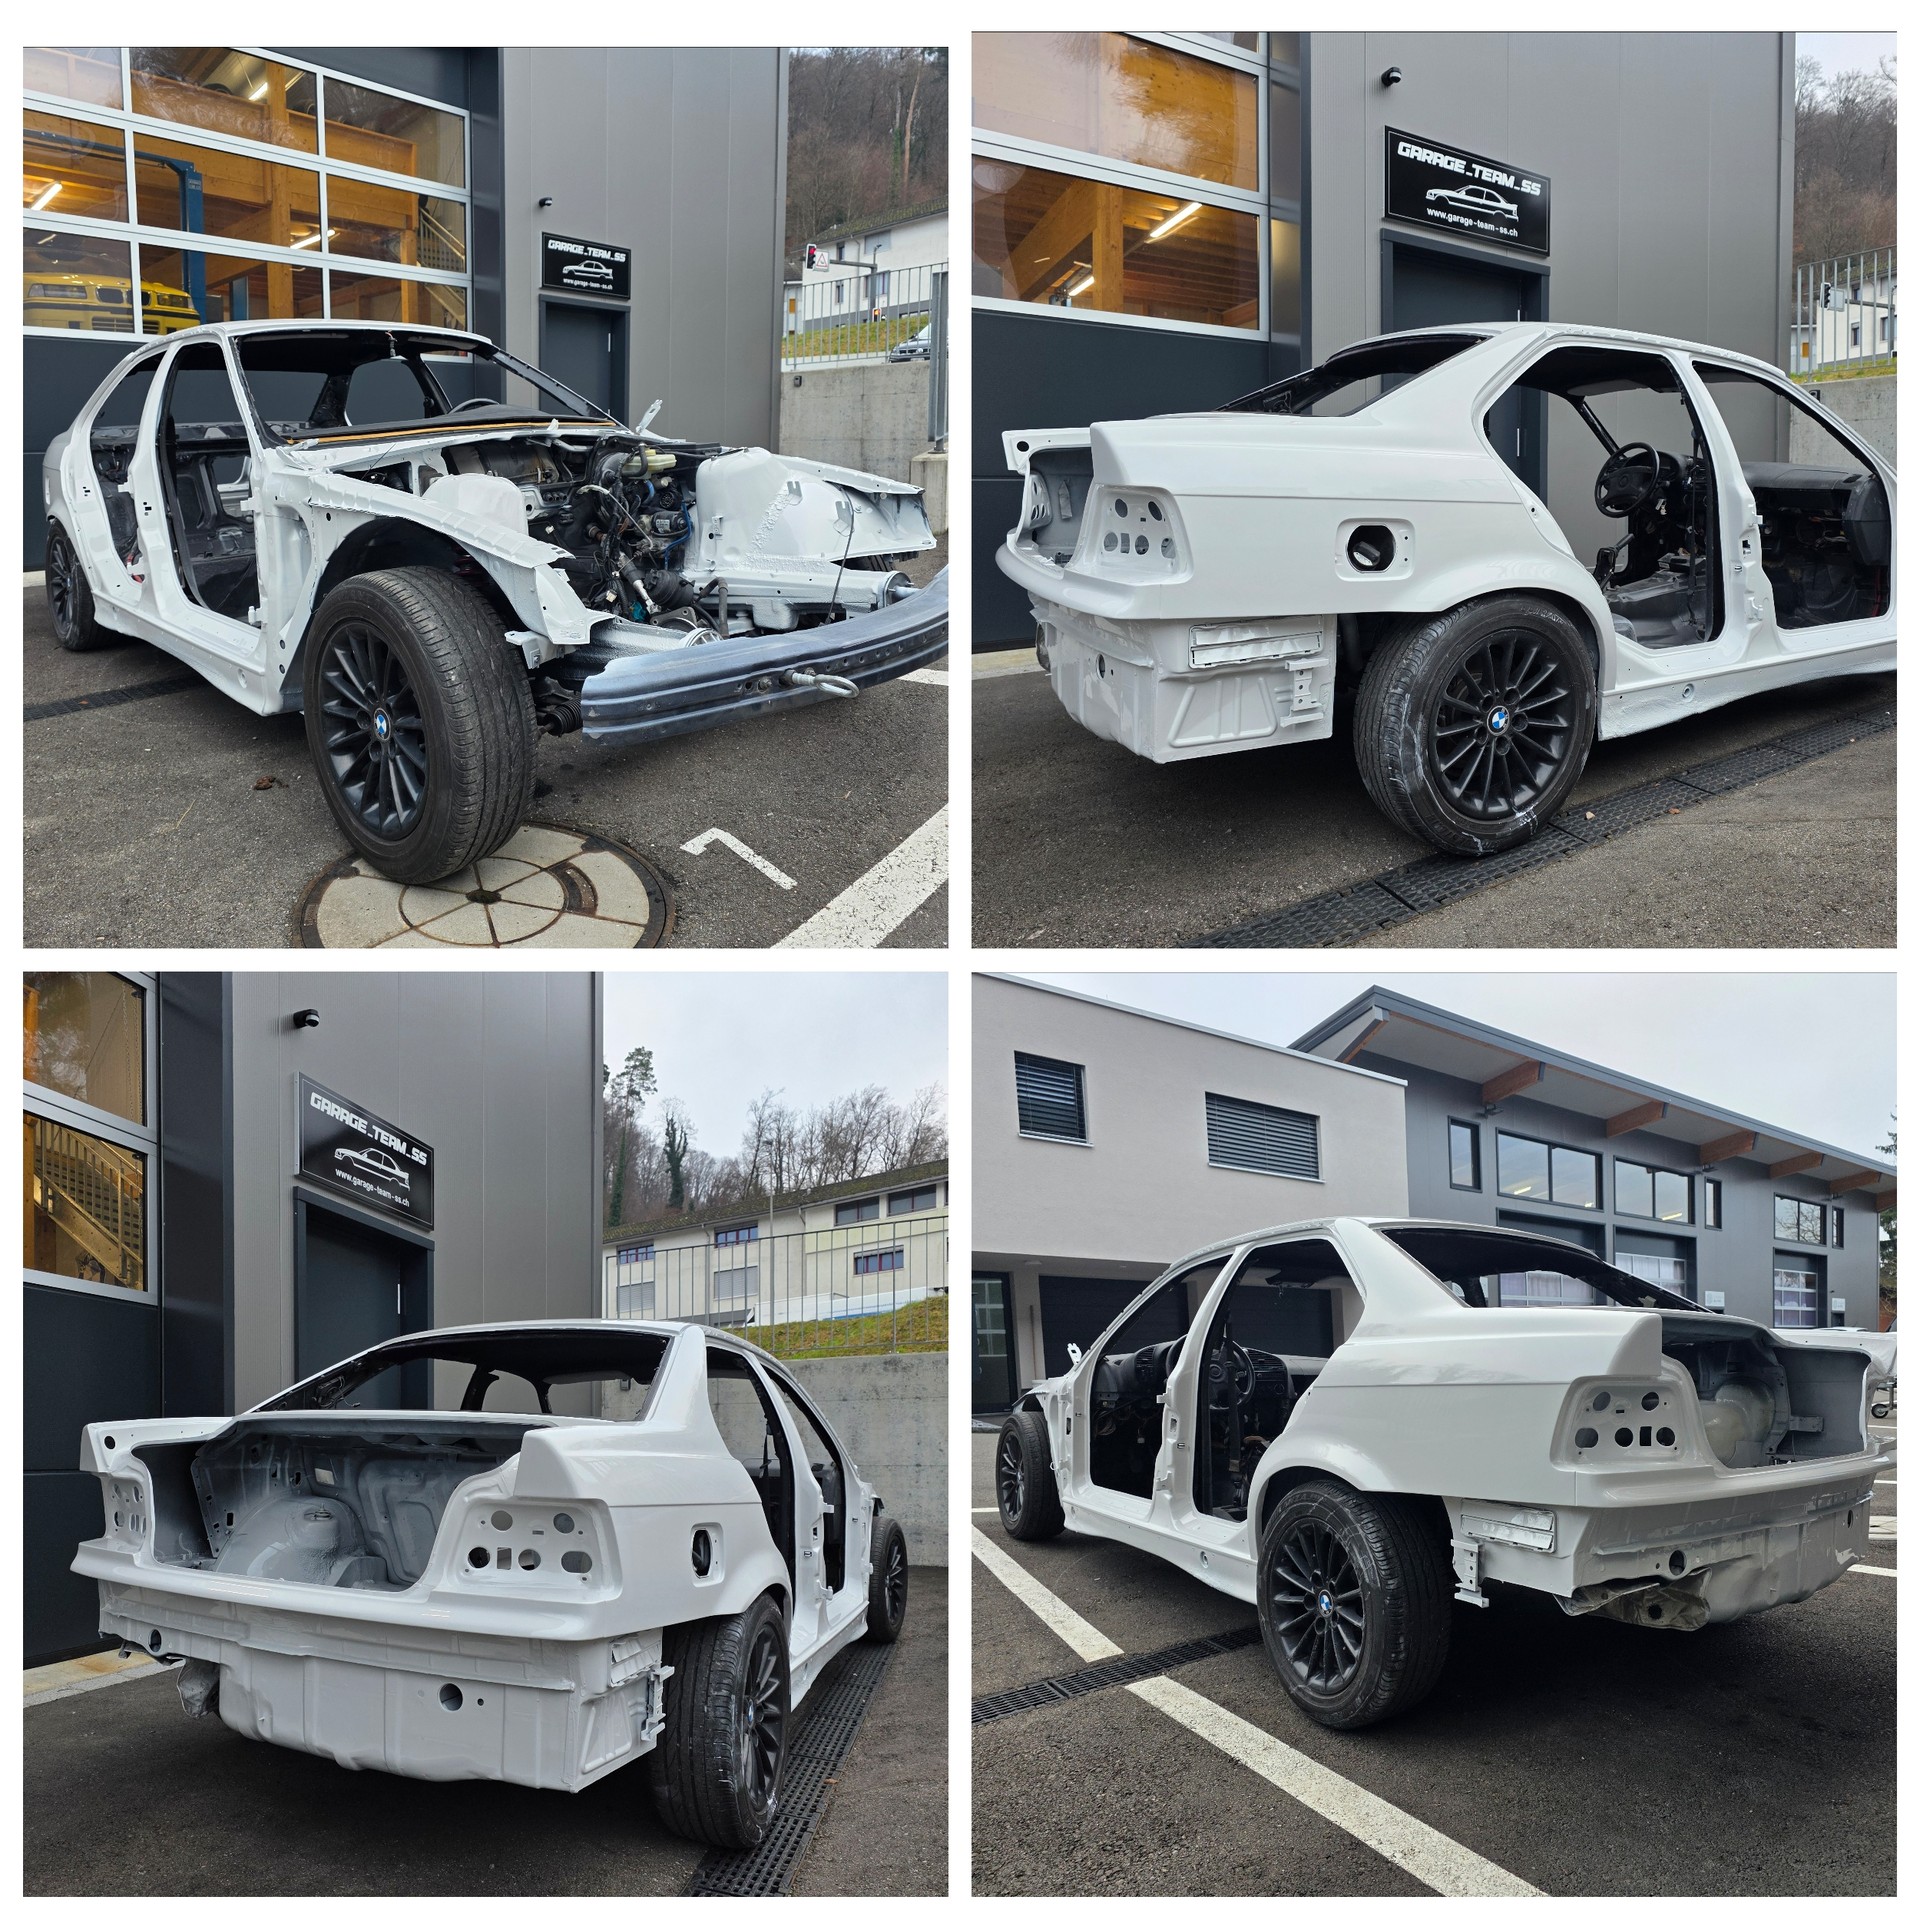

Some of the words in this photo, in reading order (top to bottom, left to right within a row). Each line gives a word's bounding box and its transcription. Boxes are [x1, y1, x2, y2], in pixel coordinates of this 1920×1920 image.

[1397, 141, 1542, 196] GARAGE_TEAM_SS
[1426, 207, 1519, 237] www.garage-team-ss.ch
[547, 239, 627, 263] GARAGE_TEAM_SS
[310, 1091, 428, 1166] GARAGE_TEAM_SS
